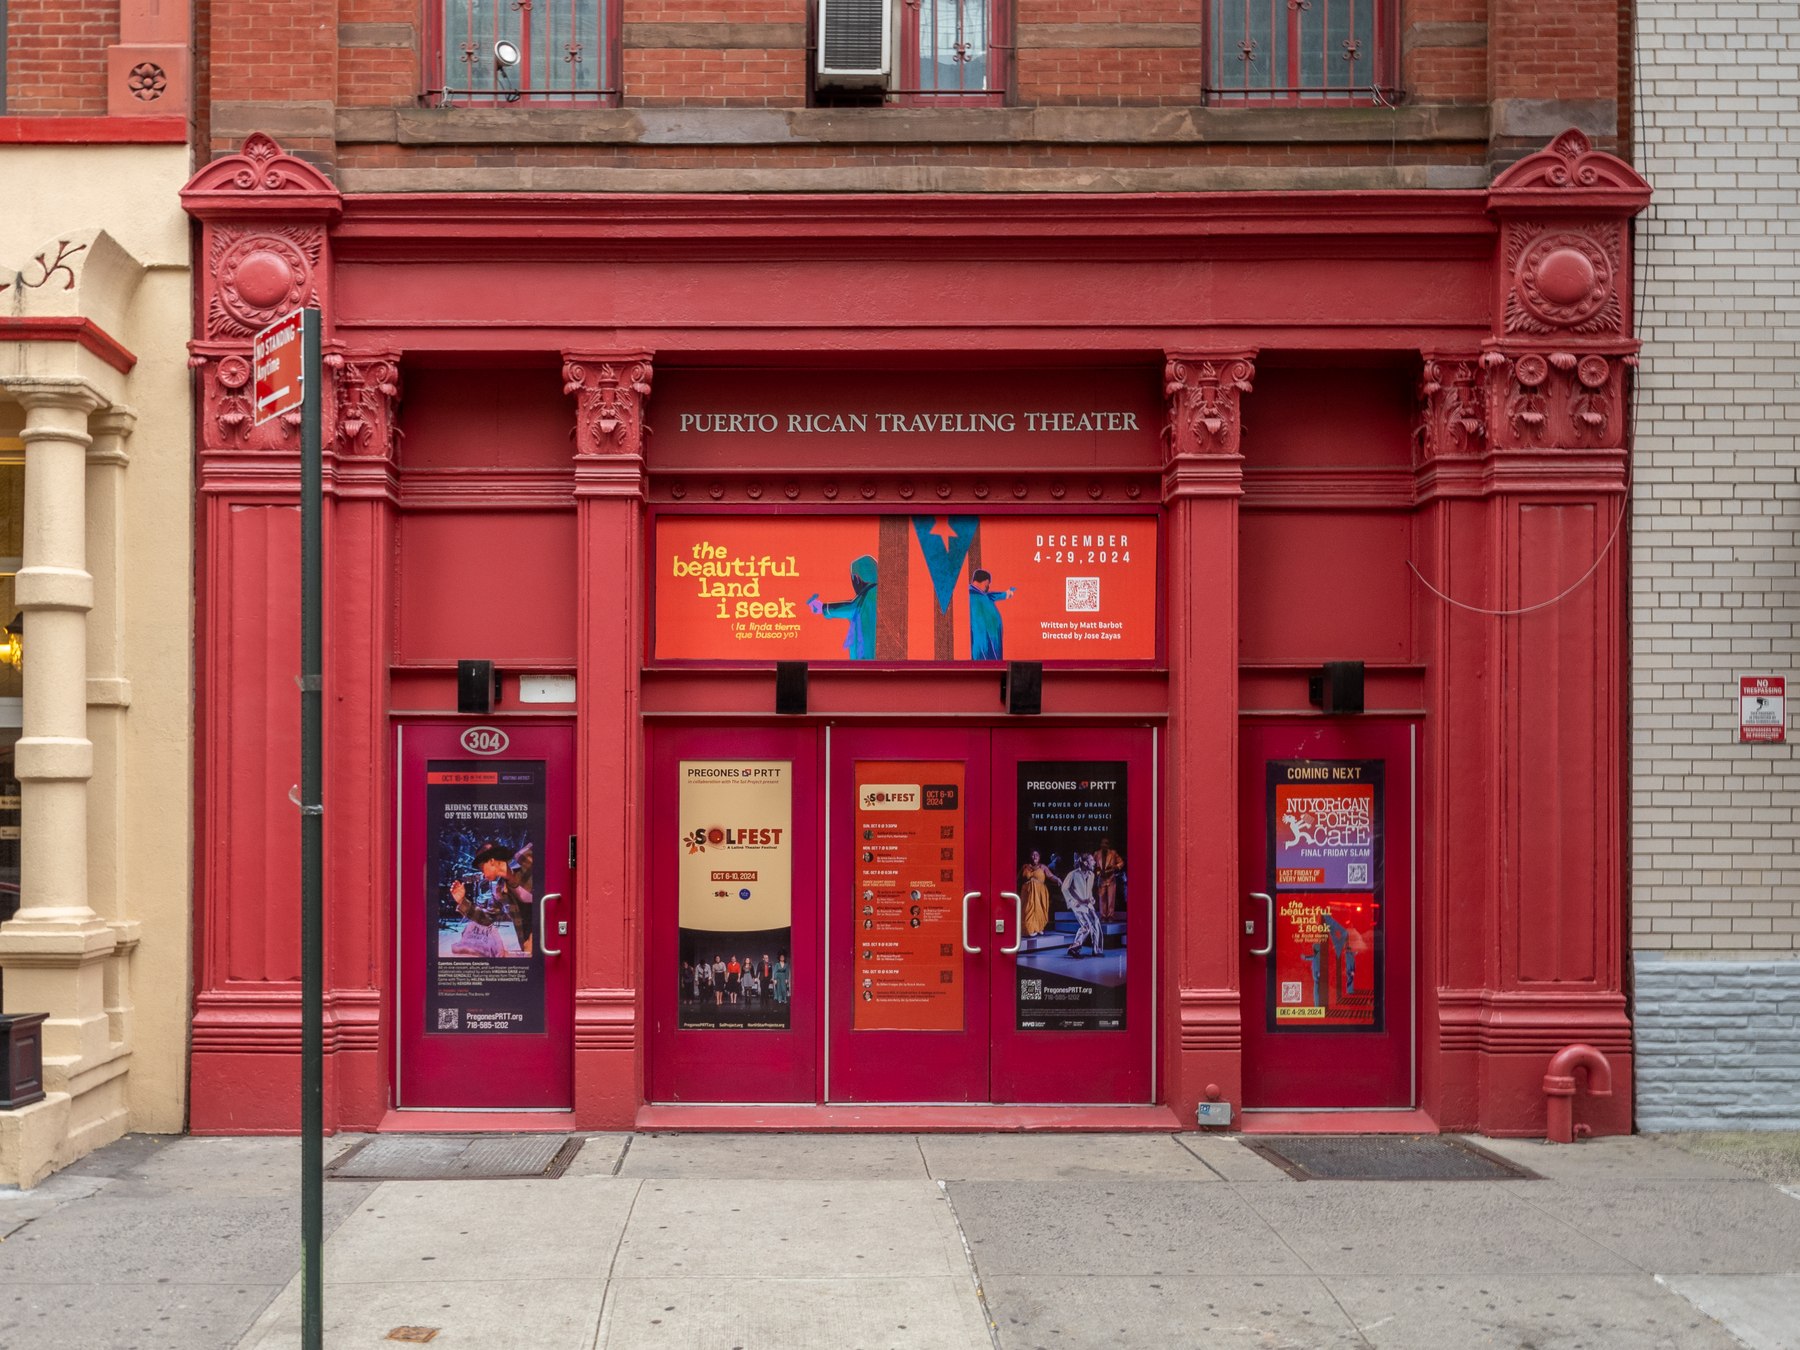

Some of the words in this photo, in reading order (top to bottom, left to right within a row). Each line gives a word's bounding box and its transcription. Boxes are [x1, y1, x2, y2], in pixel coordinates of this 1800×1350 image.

[680, 413, 778, 432] PUERTO
[787, 413, 868, 432] RICAN
[875, 413, 1016, 432] TRAVELING
[1024, 413, 1139, 432] THEATER
[1036, 535, 1128, 547] DECEMBER
[692, 542, 727, 559] the
[673, 556, 799, 577] beautiful
[698, 578, 760, 597] land
[716, 598, 730, 619] i
[735, 598, 796, 619] seek
[750, 622, 772, 631] linda
[775, 622, 800, 631] tierra
[736, 631, 752, 640] que
[756, 631, 782, 640] busco
[1757, 679, 1768, 687] NO
[469, 732, 500, 750] 304
[688, 768, 739, 777] PREGONES
[754, 768, 781, 777] PRTT
[1287, 768, 1329, 779] COMING
[1333, 768, 1361, 779] NEXT
[1027, 781, 1077, 790] PREGONES
[1090, 781, 1116, 790] PRTT
[695, 828, 782, 845] SOLFEST
[1301, 849, 1321, 857] FINAL
[1323, 849, 1348, 857] FRIDAY
[1350, 849, 1370, 857] SLAM
[1280, 906, 1332, 916] beautiful
[1291, 916, 1316, 924] land
[1298, 924, 1304, 932] i
[1306, 924, 1330, 932] seek
